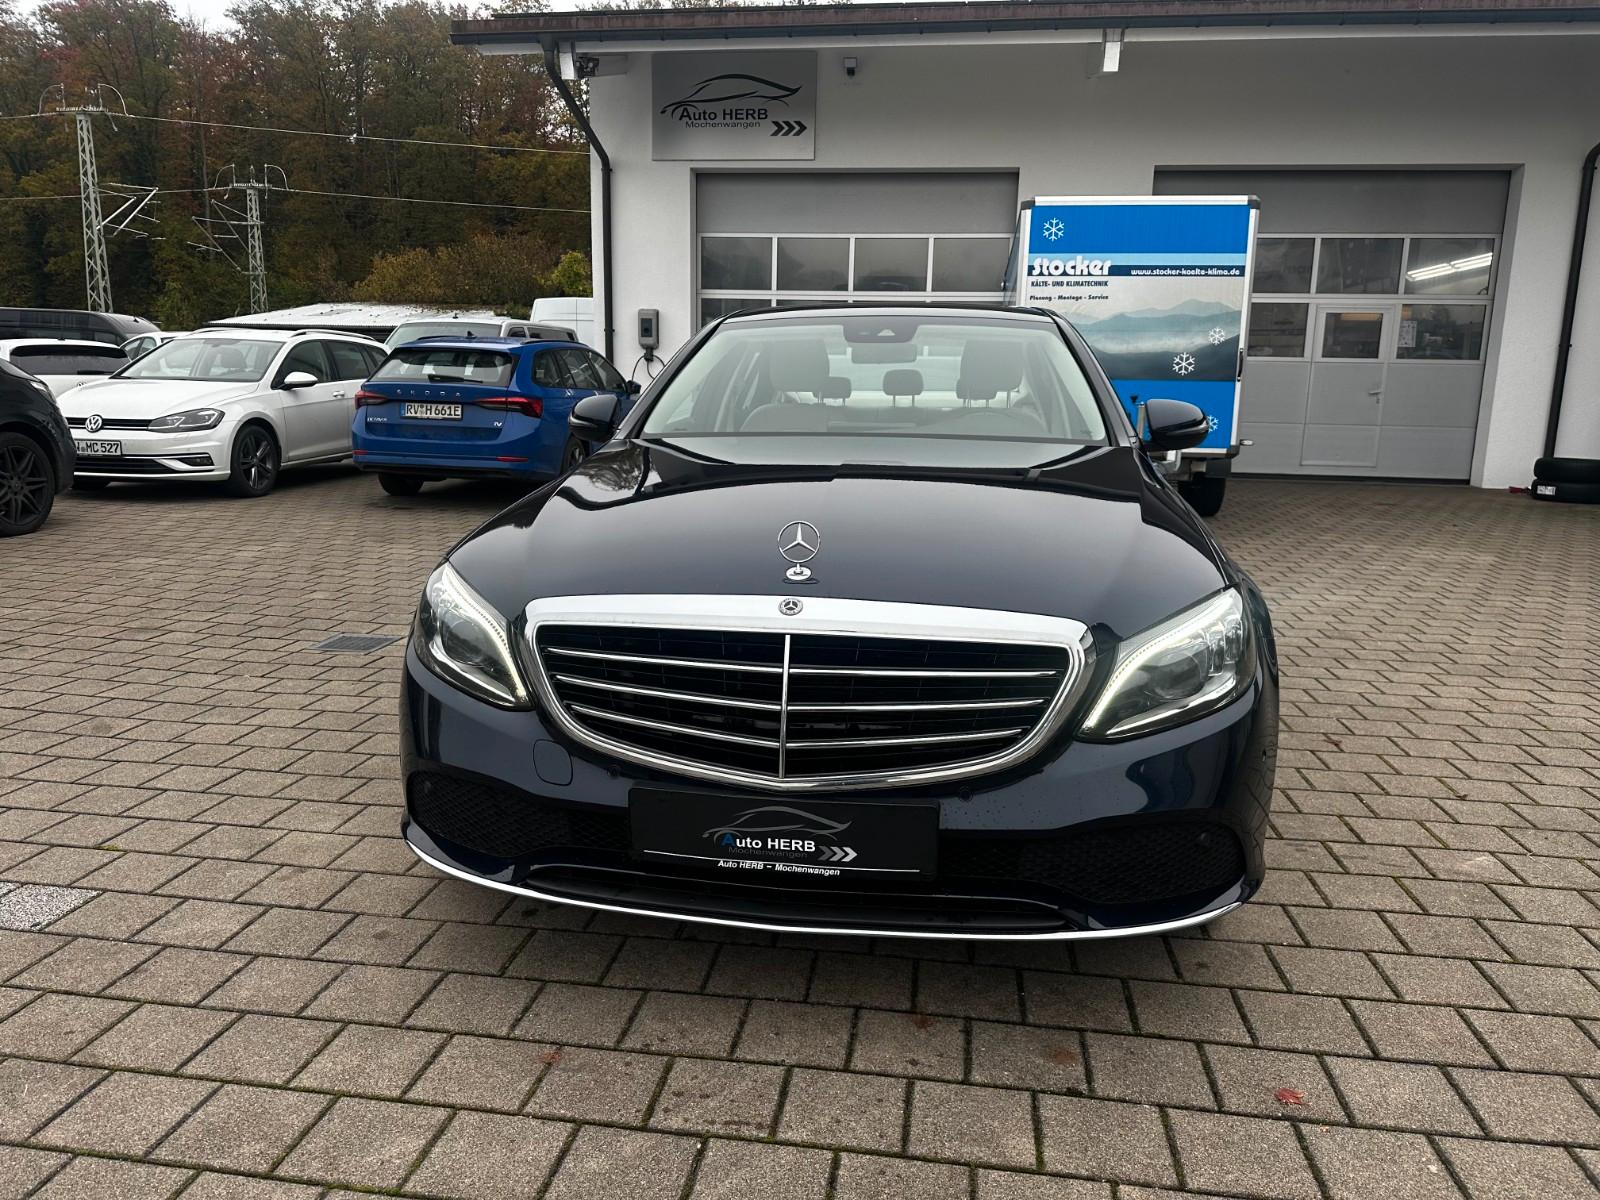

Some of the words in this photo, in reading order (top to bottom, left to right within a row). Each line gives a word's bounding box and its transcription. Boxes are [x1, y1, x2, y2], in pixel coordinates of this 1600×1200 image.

[679, 107, 717, 121] Auto
[722, 108, 768, 120] HERB
[686, 121, 761, 129] Mochenwangen
[1031, 279, 1050, 287] KÄLTE-
[406, 404, 419, 415] RV
[425, 405, 432, 415] H
[434, 405, 460, 417] 661E
[86, 442, 99, 453] MC
[100, 443, 119, 454] 527
[722, 832, 762, 849] Auto
[767, 838, 816, 852] HERB
[728, 847, 808, 858] Mochenwangen
[718, 860, 737, 868] Auto
[739, 861, 764, 870] HERB
[775, 864, 840, 875] Mochenwangen
